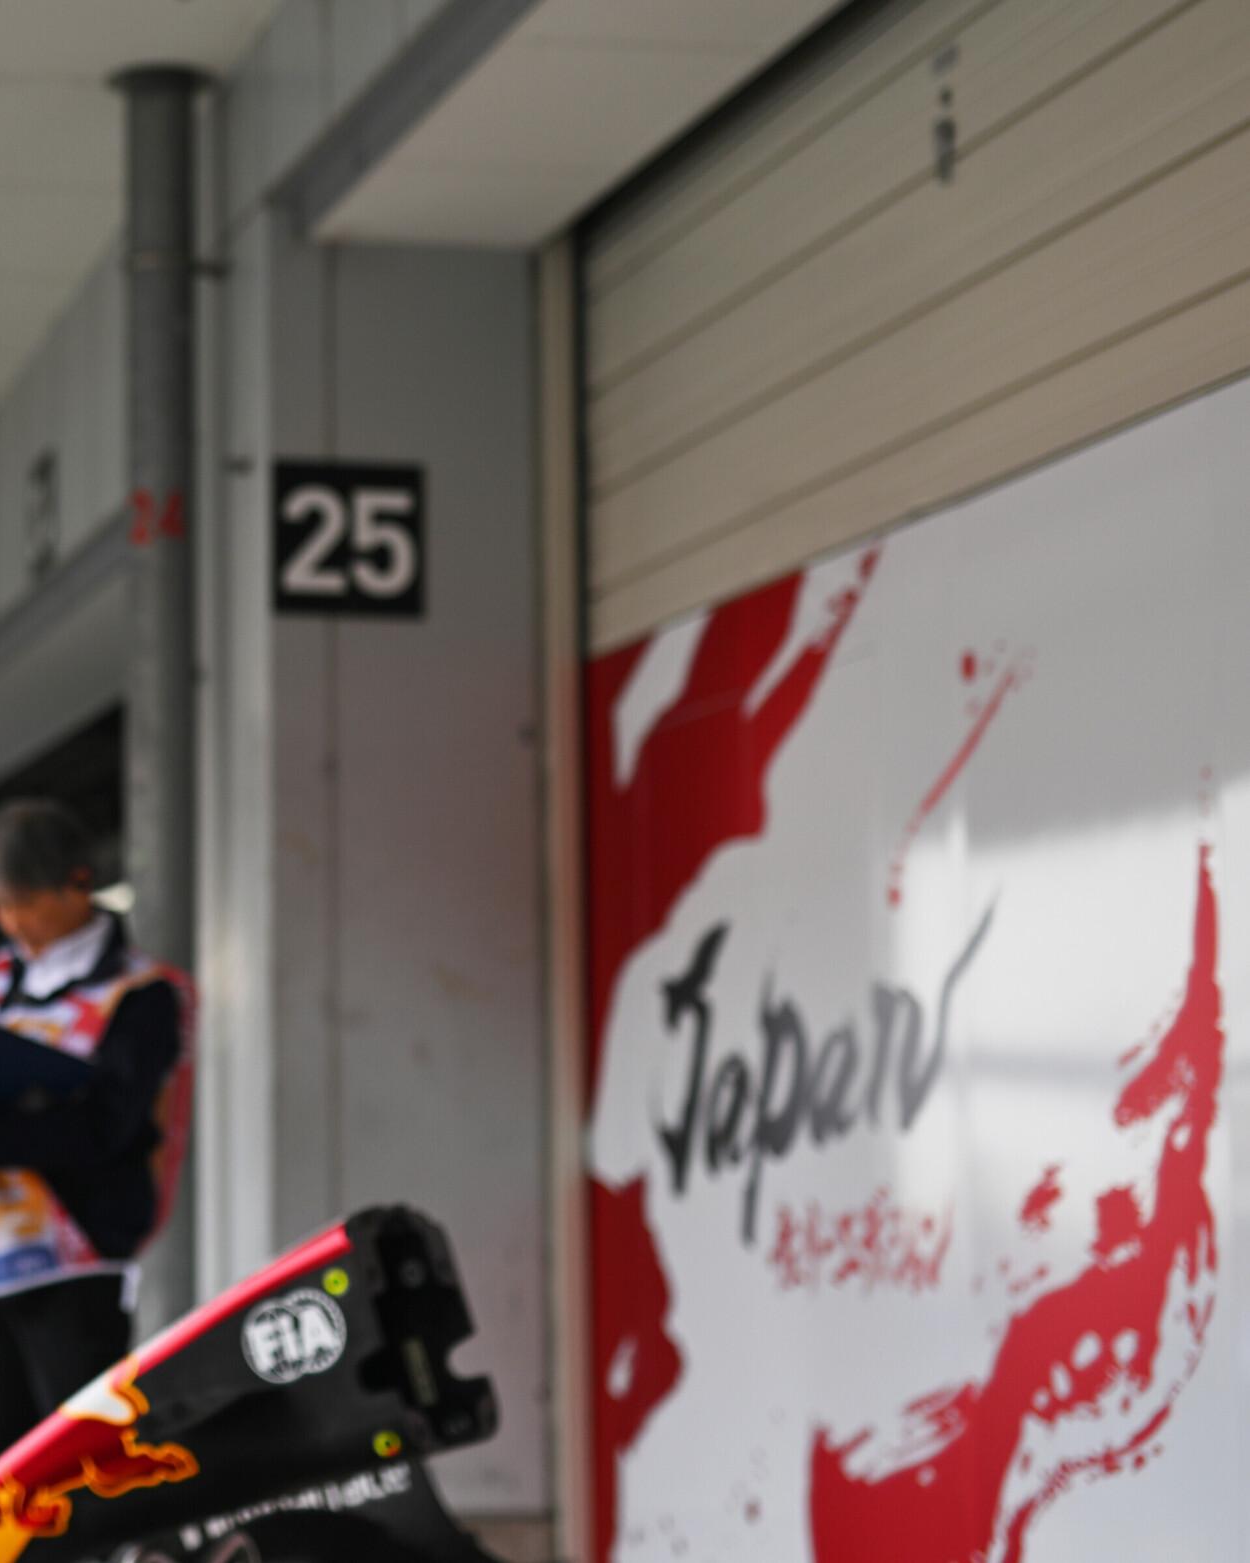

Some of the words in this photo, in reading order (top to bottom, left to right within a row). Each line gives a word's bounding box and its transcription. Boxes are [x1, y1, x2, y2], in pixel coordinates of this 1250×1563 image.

[281, 484, 417, 598] 25
[655, 900, 997, 1247] Japan
[248, 1308, 341, 1371] FIA
